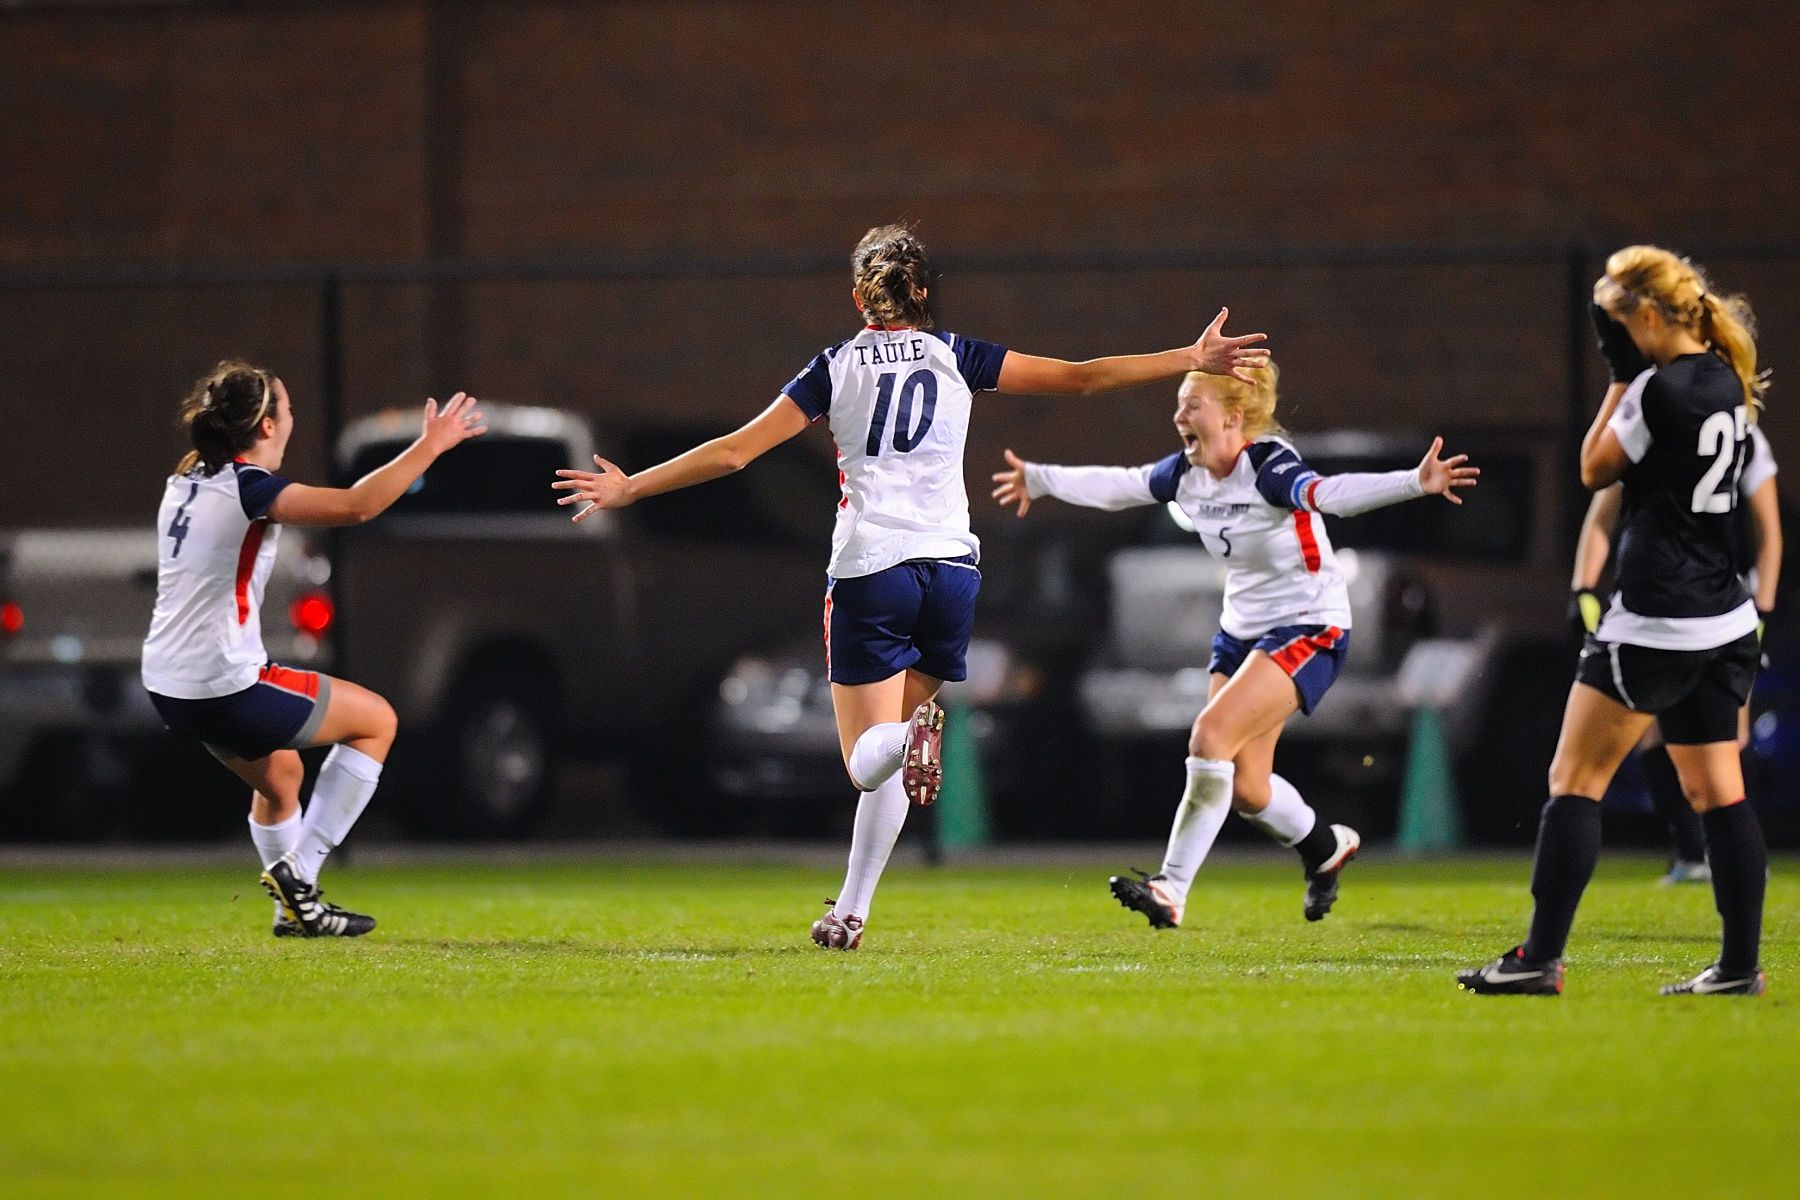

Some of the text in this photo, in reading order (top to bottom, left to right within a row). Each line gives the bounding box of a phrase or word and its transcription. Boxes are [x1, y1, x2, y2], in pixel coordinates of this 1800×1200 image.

[855, 339, 925, 366] TAULE
[866, 369, 938, 457] 10
[167, 482, 199, 559] 4
[1219, 526, 1232, 558] 5
